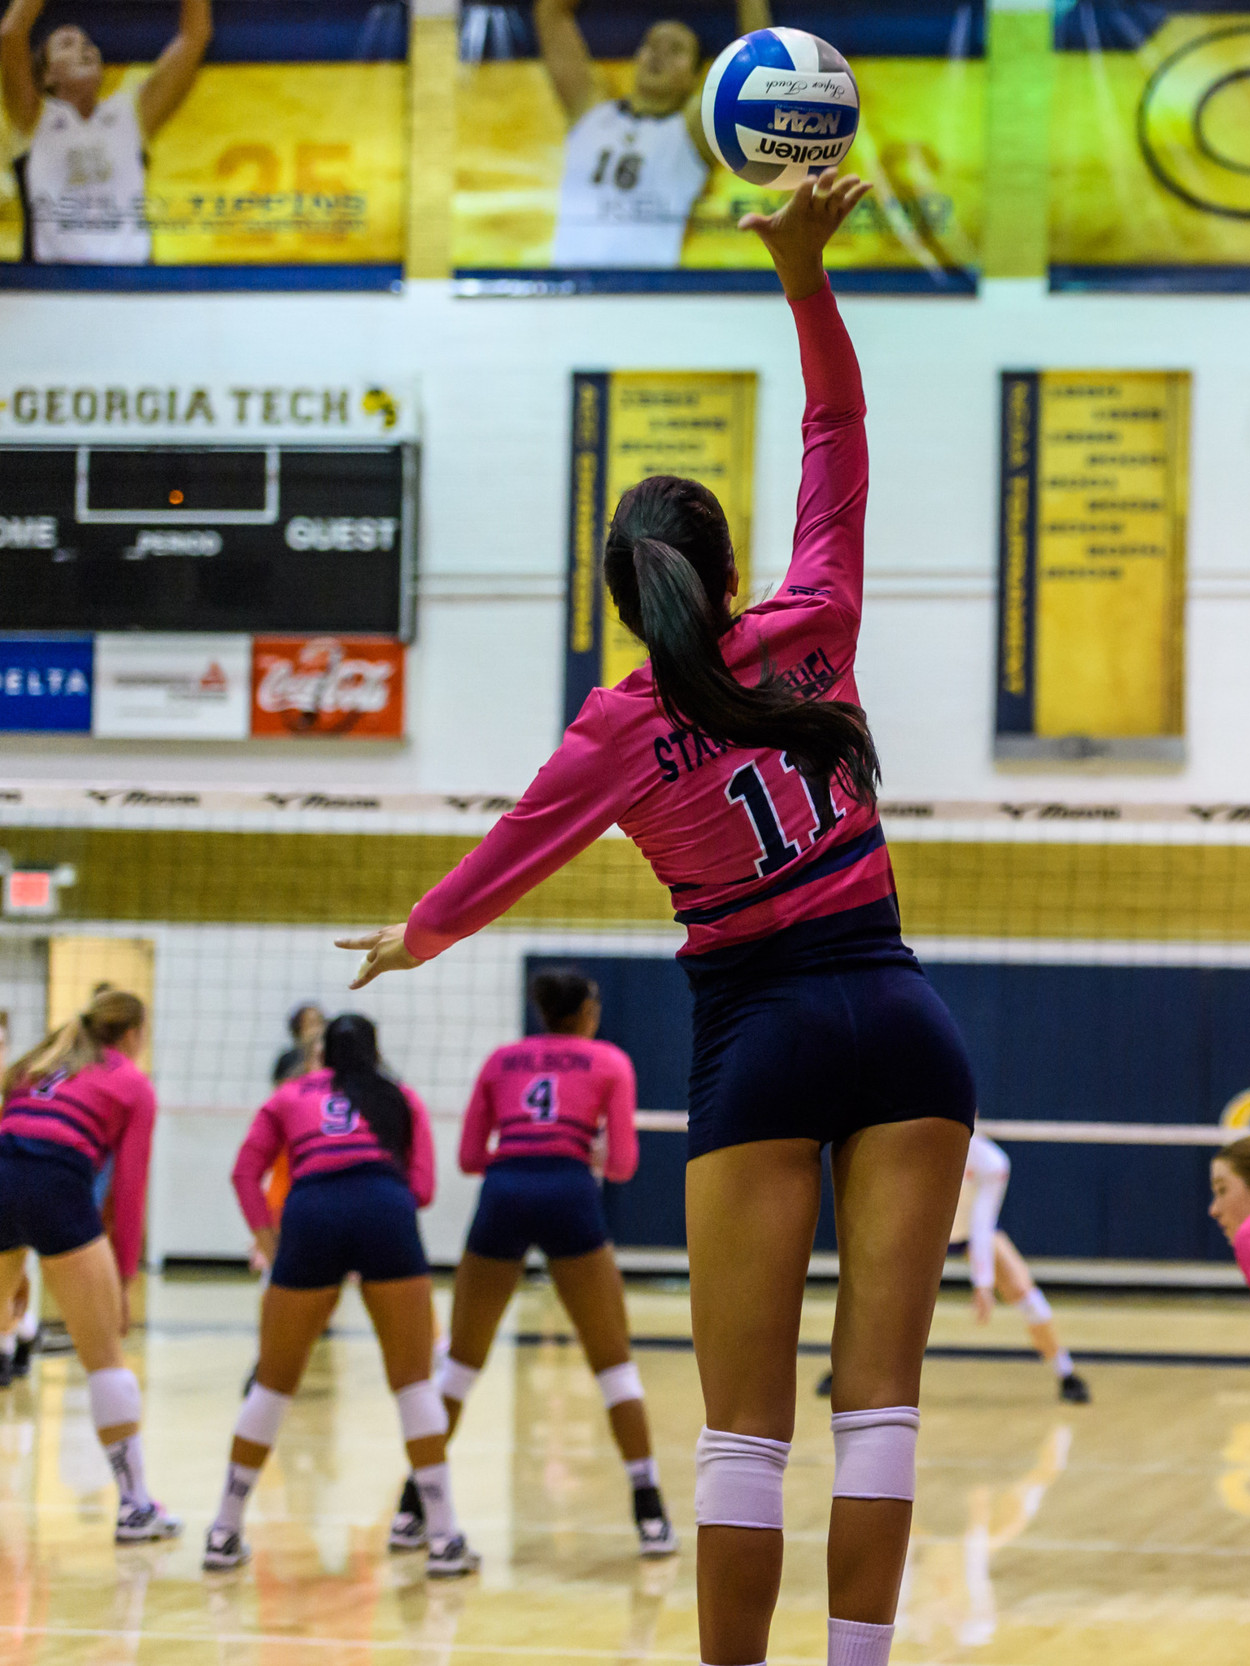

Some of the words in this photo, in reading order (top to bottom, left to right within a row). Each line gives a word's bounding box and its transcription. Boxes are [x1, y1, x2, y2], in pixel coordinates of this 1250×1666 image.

[766, 80, 808, 95] Touch
[812, 79, 845, 99] Super
[774, 108, 841, 134] NCAA
[760, 138, 842, 163] molten
[590, 148, 645, 190] 16
[13, 385, 214, 425] GEORGIA
[229, 386, 349, 425] TECH
[286, 515, 397, 551] GUEST
[0, 667, 89, 696] ELTA
[724, 750, 847, 878] 11
[320, 1094, 361, 1137] 9
[522, 1073, 559, 1124] 4
